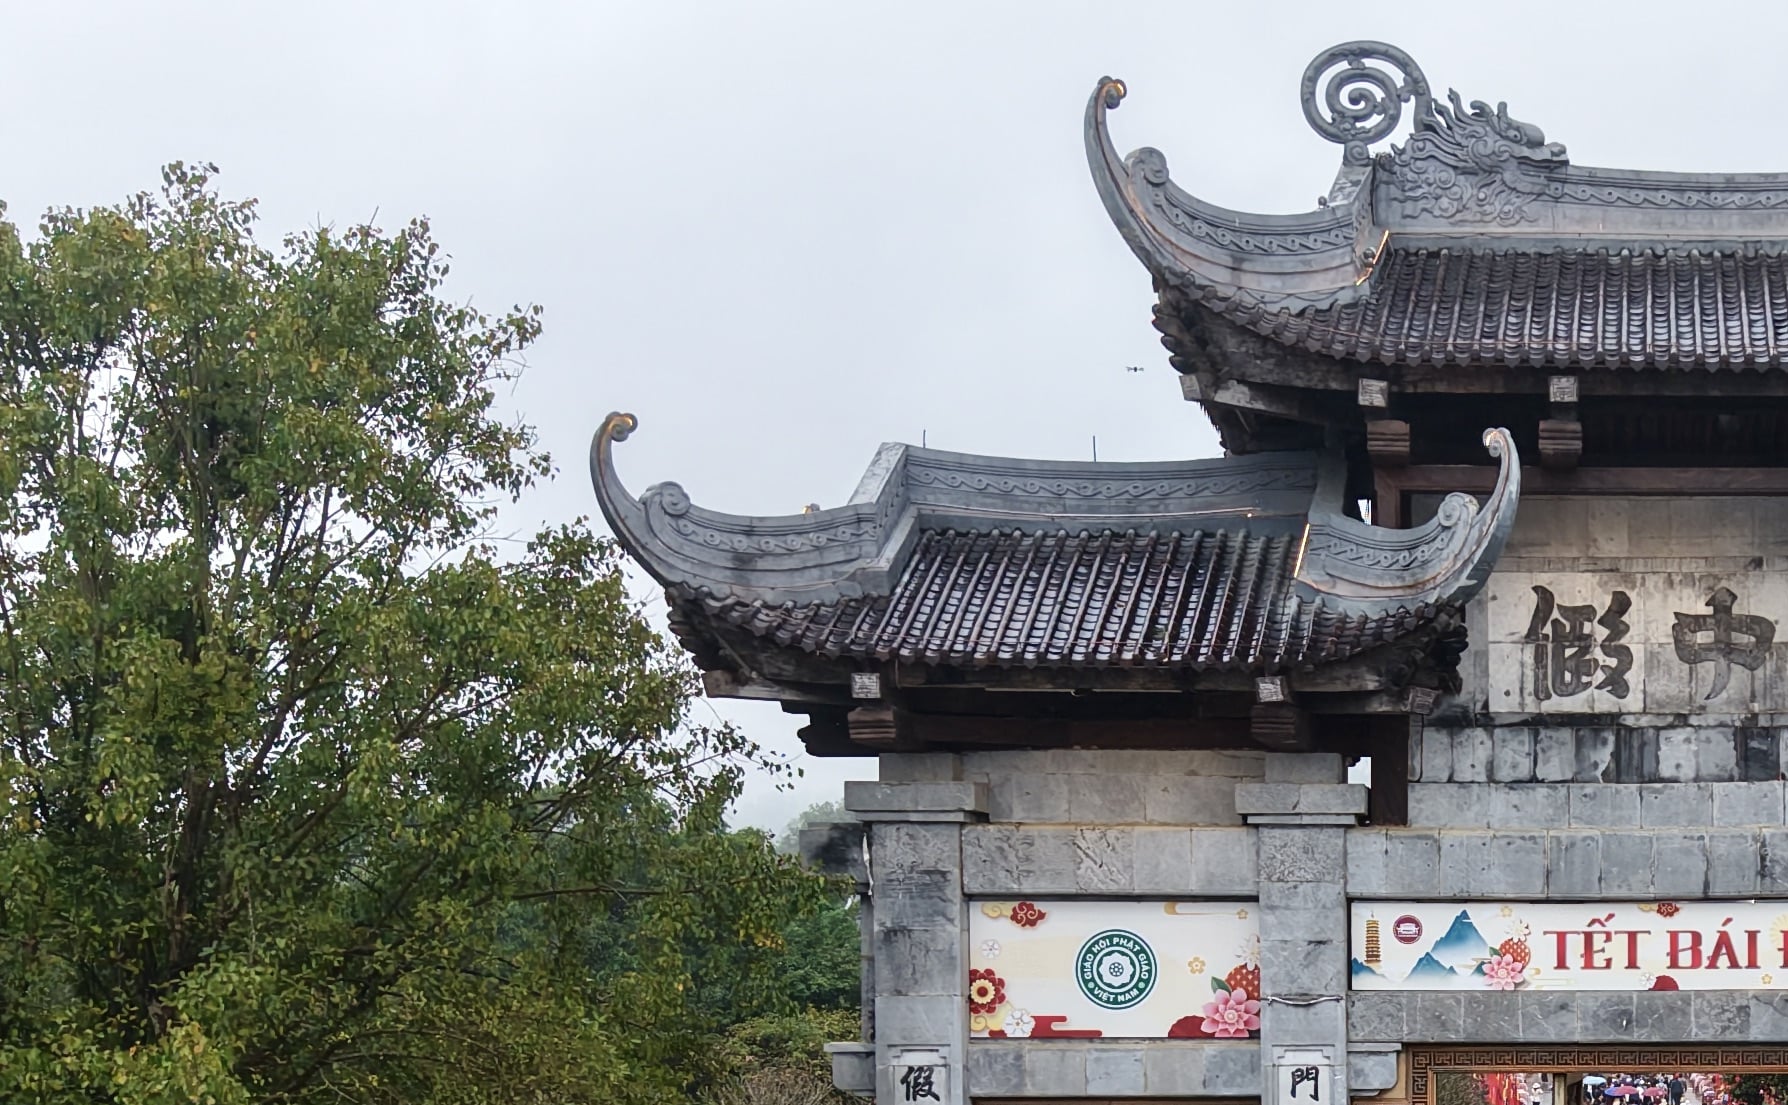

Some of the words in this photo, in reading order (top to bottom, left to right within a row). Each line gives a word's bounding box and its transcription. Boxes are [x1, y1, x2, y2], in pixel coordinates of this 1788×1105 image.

[1082, 954, 1094, 979] GIÁO
[1092, 938, 1110, 953] HỘI
[1112, 937, 1140, 952] PHẬT
[1138, 953, 1150, 979] GIÁO
[1543, 913, 1652, 970] TẾT
[1666, 918, 1761, 970] BÁI
[1093, 987, 1115, 1001] VIỆT
[1117, 988, 1139, 1002] NAM
